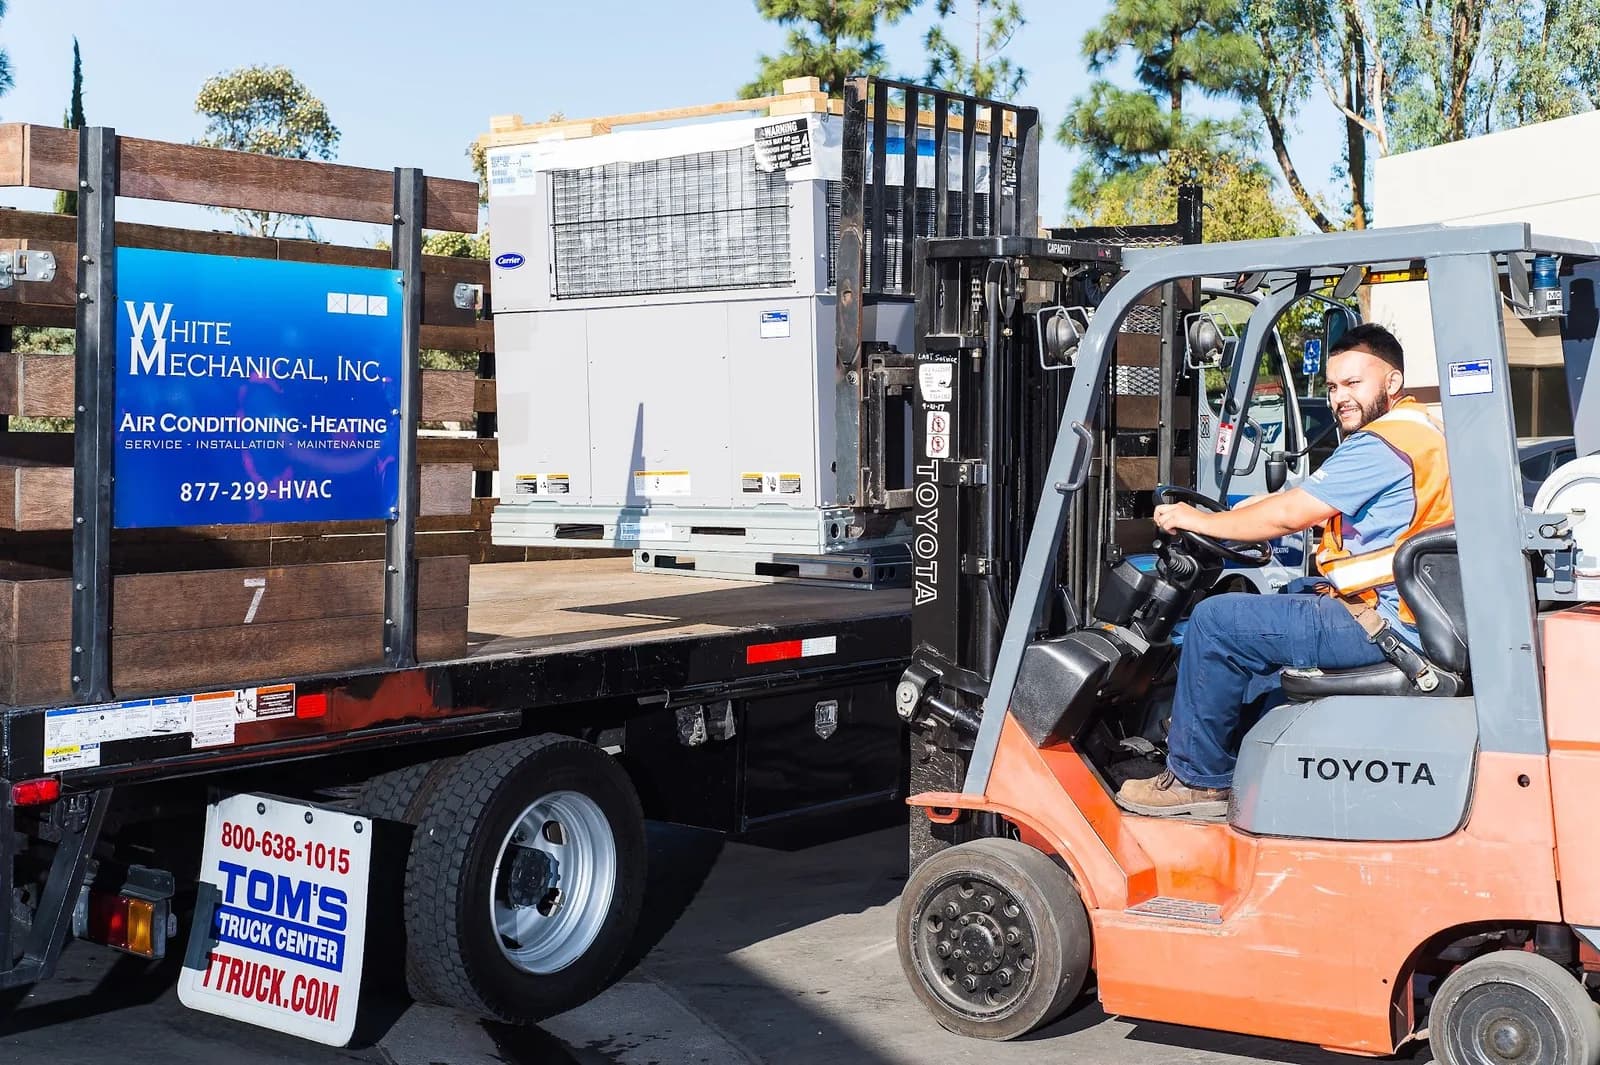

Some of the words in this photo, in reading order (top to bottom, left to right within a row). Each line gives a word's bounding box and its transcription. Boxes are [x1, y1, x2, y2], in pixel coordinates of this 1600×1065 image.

[764, 122, 798, 138] WARNING
[498, 256, 521, 265] Carrier
[1047, 243, 1072, 255] CAPACITY
[124, 301, 231, 345] WHITE
[129, 337, 329, 384] MECHANICAL,
[337, 356, 388, 382] INC.
[119, 413, 155, 433] AIR
[160, 413, 299, 433] CONDITIONING
[311, 415, 387, 433] HEATING
[125, 439, 183, 449] SERVICE
[196, 440, 285, 449] INSTALLATION
[297, 440, 381, 449] MAINTENANCE
[180, 479, 332, 502] 877-299-HVAC
[915, 459, 939, 606] TOYOTA
[243, 578, 266, 623] 7
[1298, 757, 1436, 786] TOYOTA
[221, 821, 351, 875] 800-638-1015
[218, 860, 348, 931] TOM'S
[220, 912, 273, 947] TRUCK
[275, 924, 338, 965] CENTER
